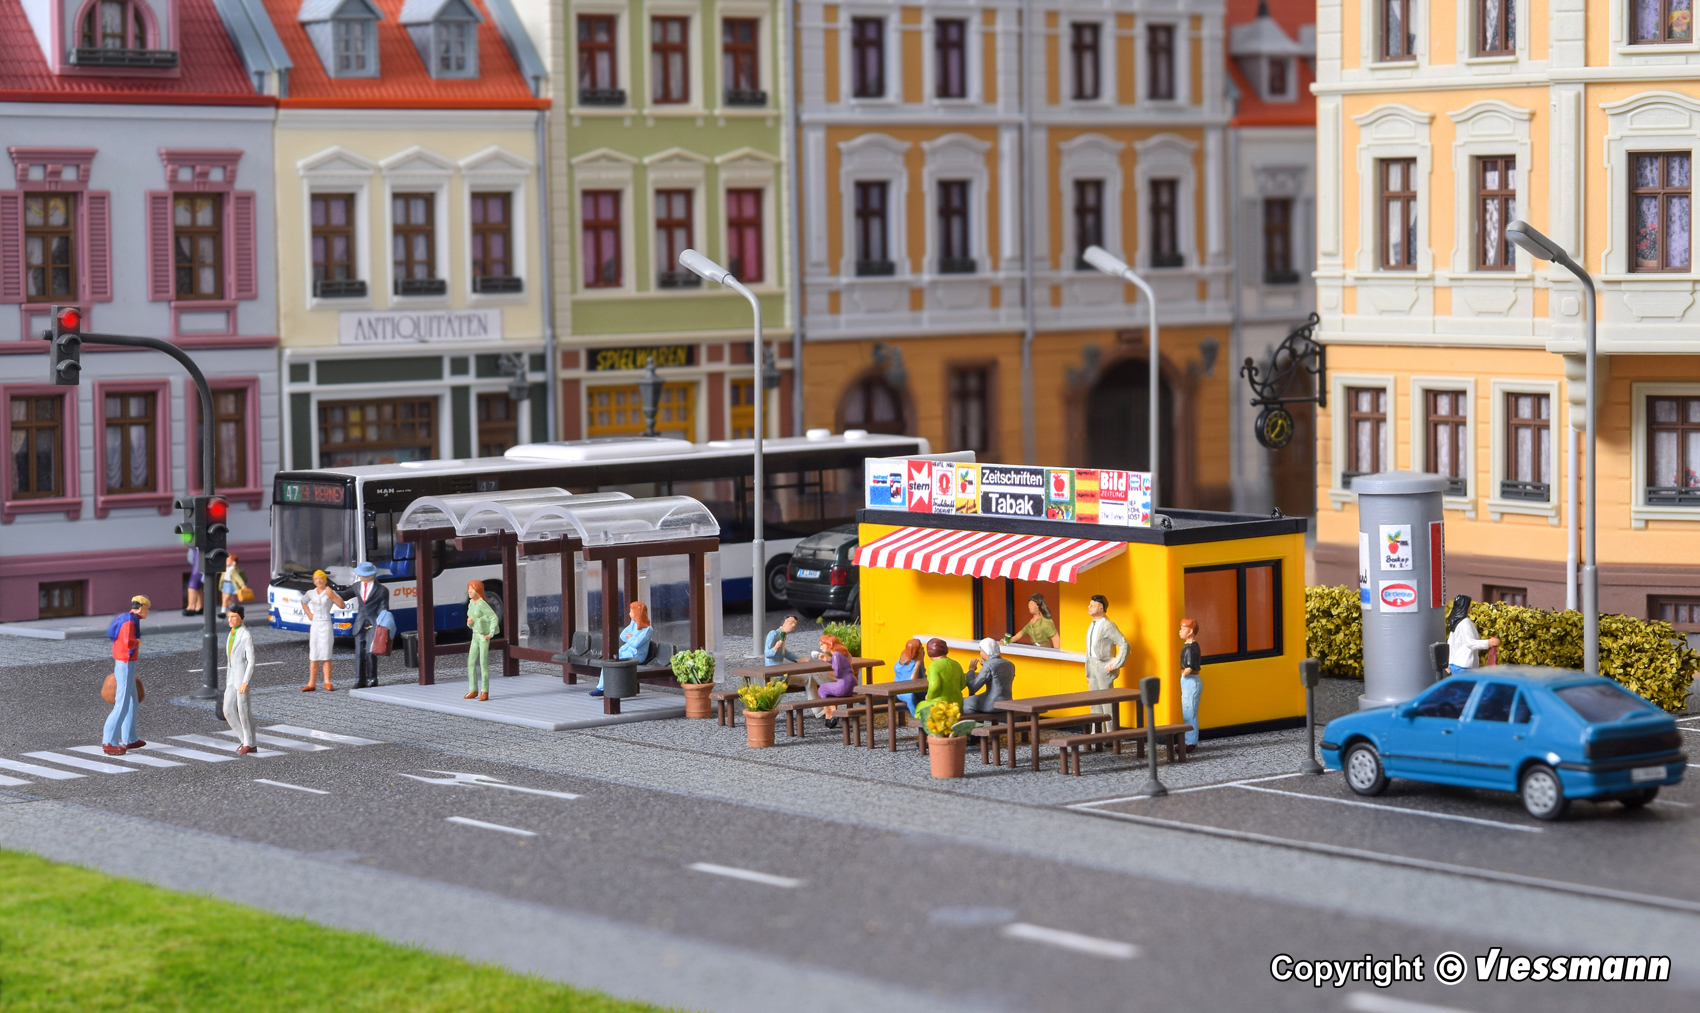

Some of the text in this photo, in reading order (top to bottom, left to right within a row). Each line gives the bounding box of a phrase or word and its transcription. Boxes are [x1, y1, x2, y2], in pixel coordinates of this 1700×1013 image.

[909, 481, 930, 491] stern
[982, 469, 1043, 486] Zeitschriften
[1100, 472, 1126, 491] Bild
[286, 485, 299, 501] 47
[988, 493, 1034, 515] Tabak
